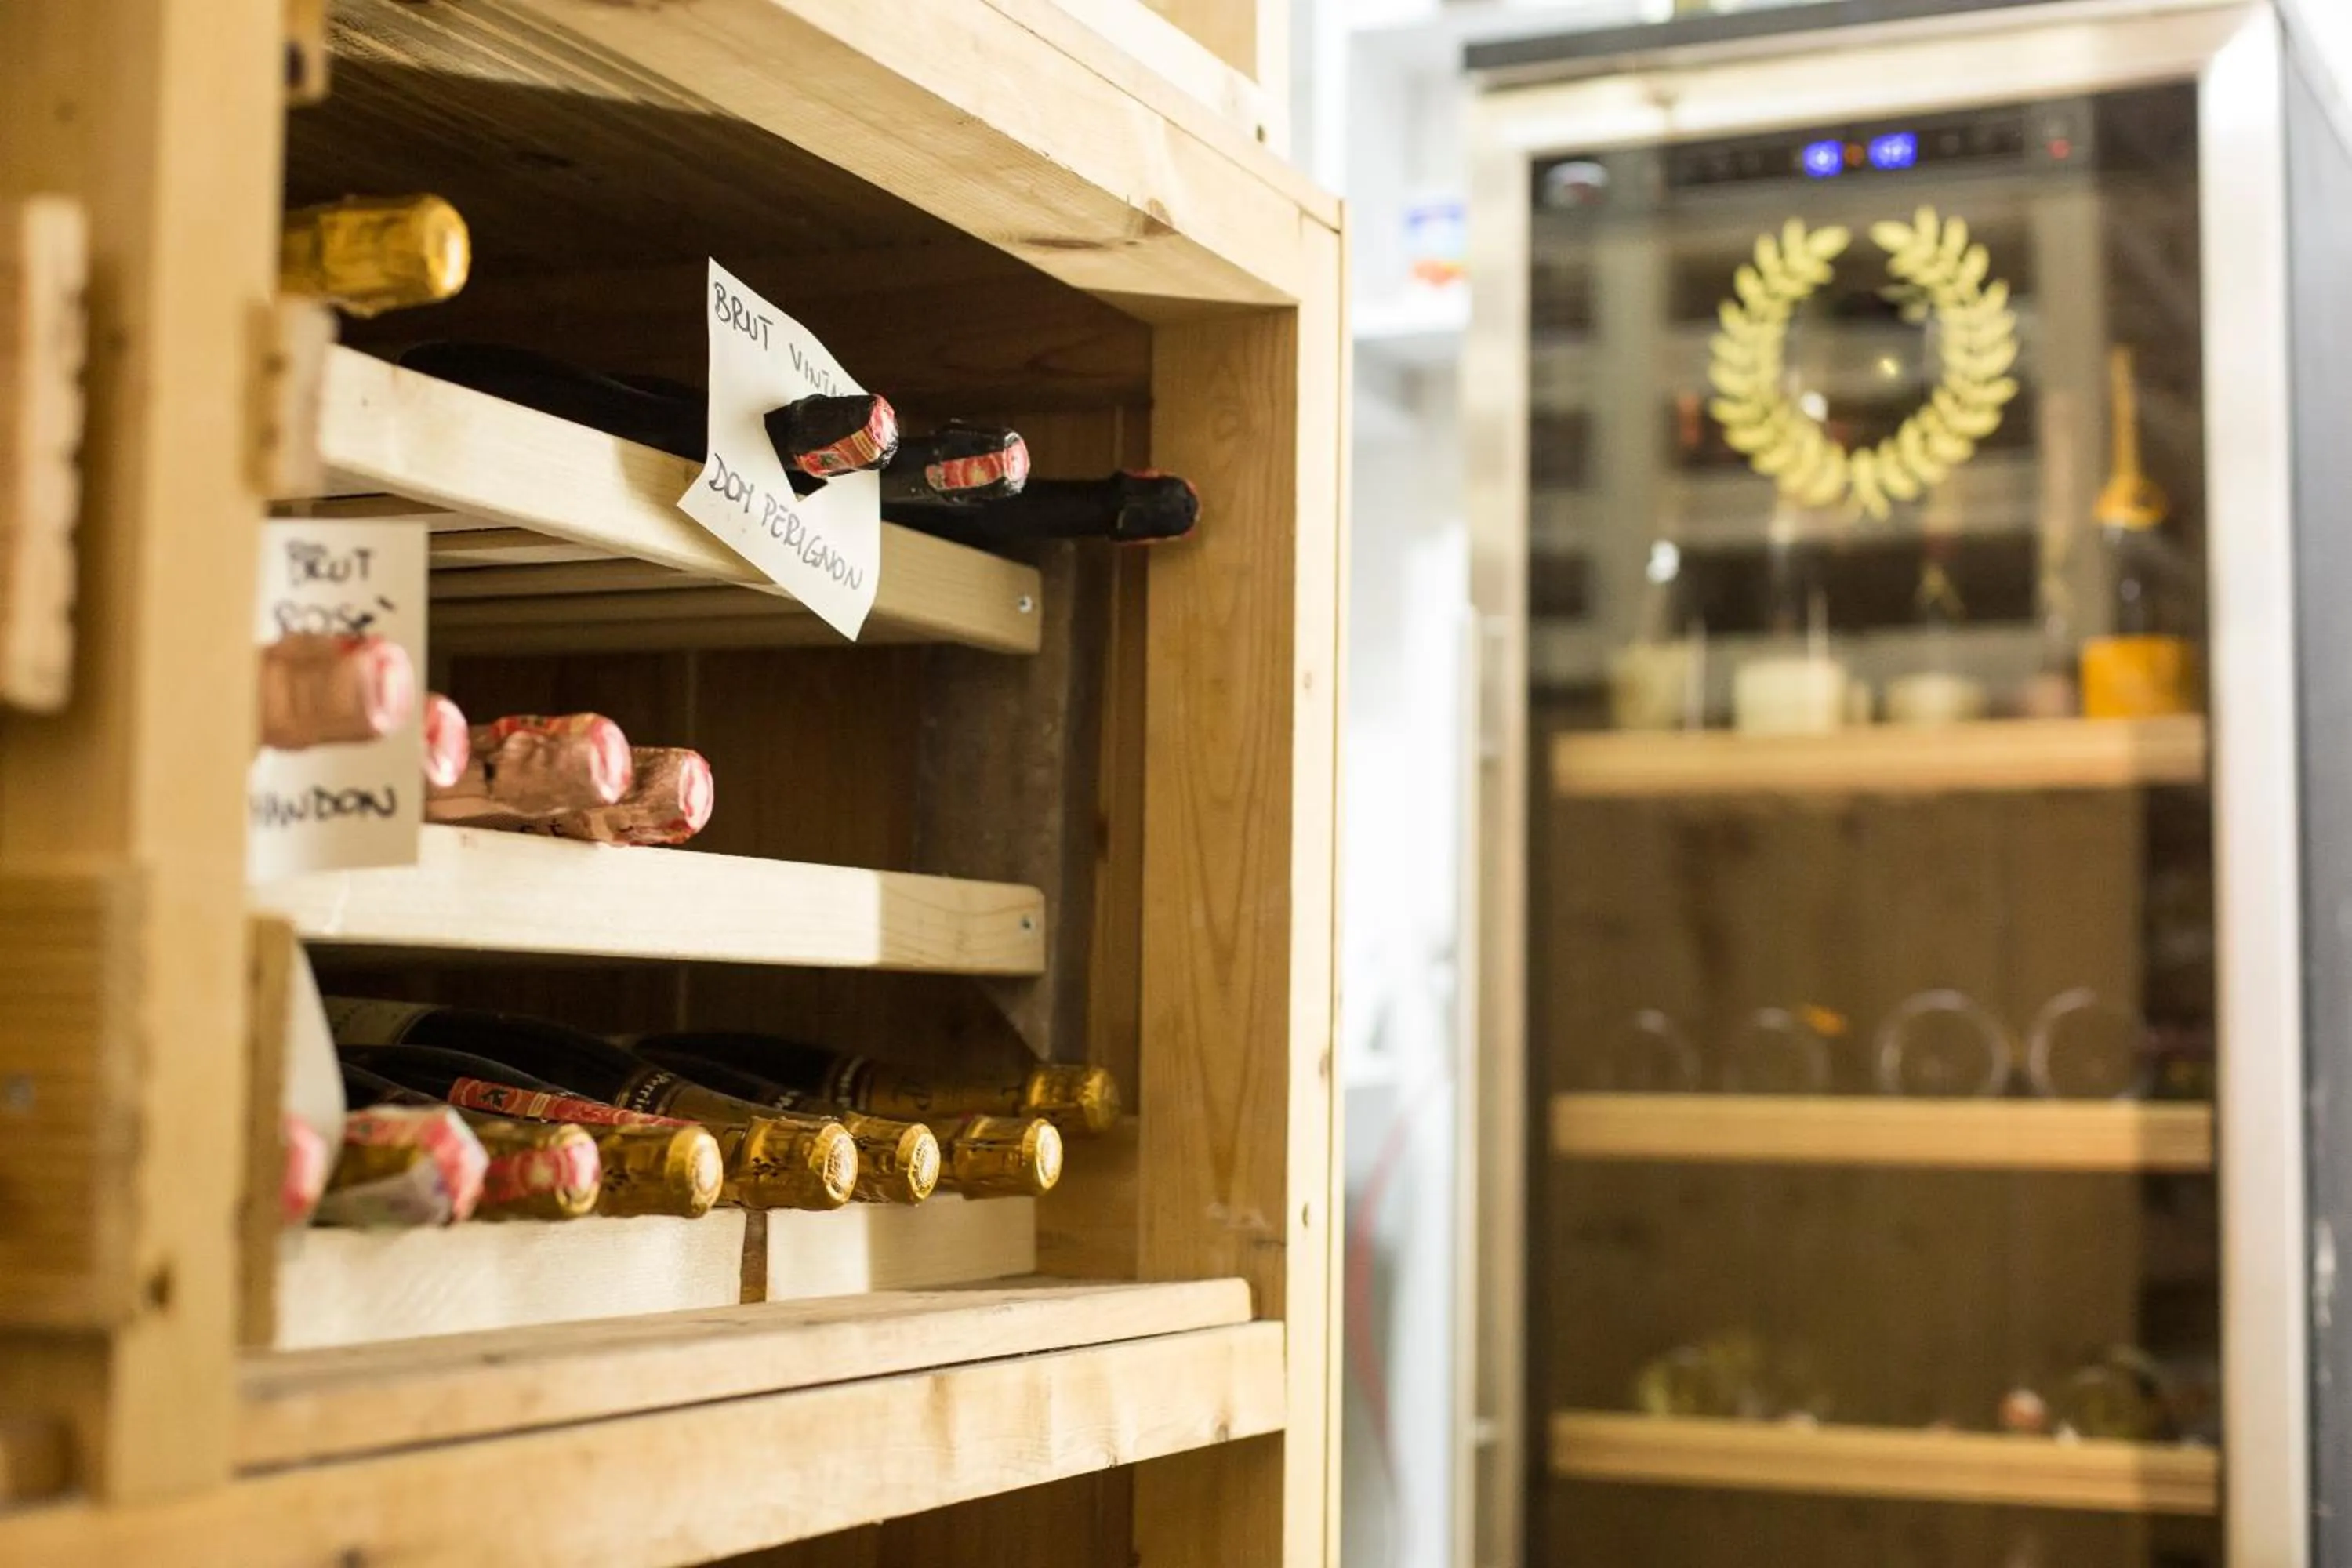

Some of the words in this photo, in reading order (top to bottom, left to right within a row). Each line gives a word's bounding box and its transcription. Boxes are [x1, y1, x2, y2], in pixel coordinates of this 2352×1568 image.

[714, 281, 773, 351] BRUT
[709, 452, 754, 513] DOM
[285, 538, 373, 587] BRUT
